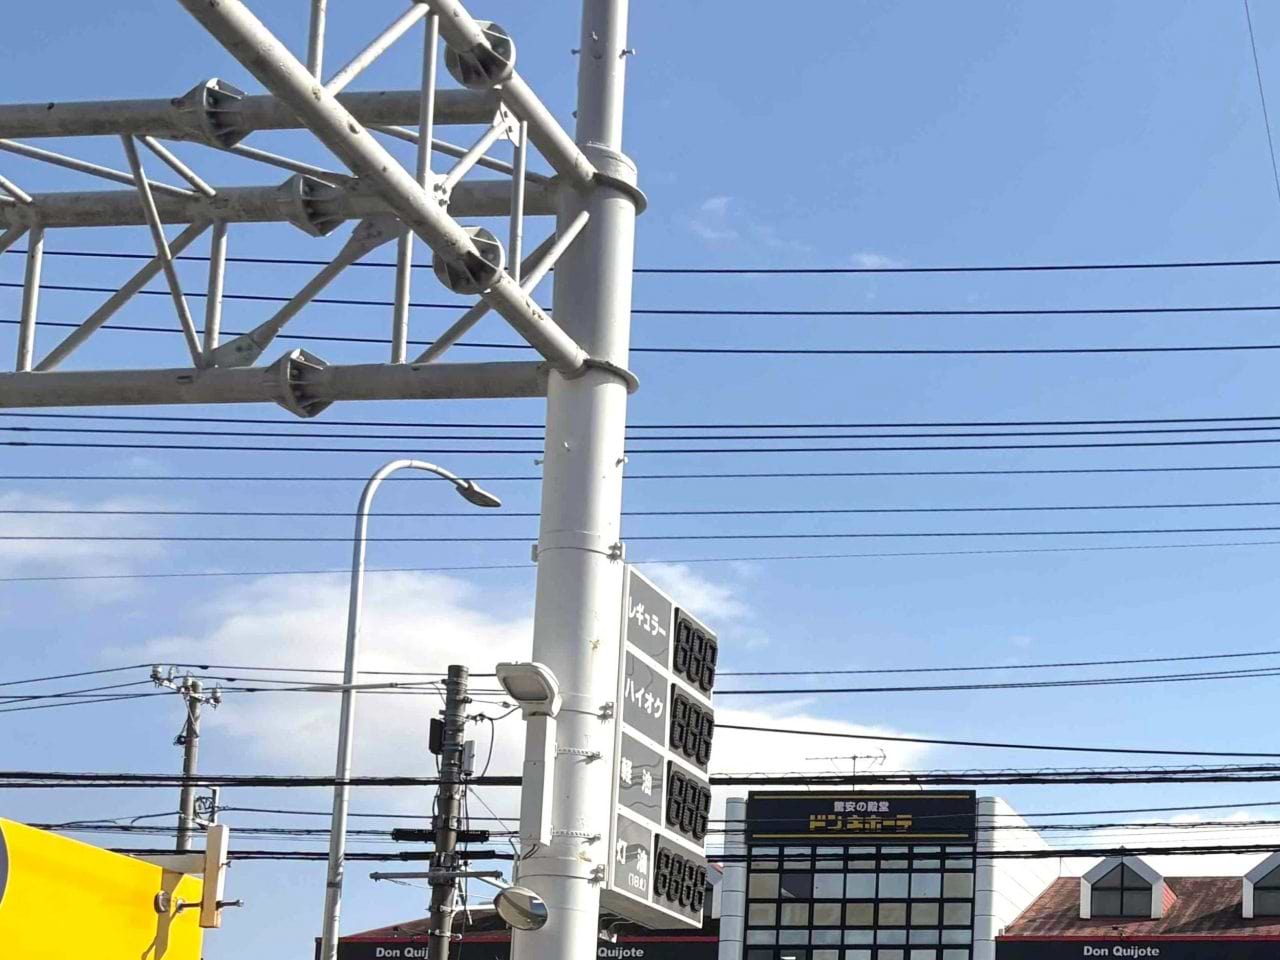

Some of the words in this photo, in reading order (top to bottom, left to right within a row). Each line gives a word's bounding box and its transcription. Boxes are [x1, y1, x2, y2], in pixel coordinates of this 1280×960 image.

[627, 596, 667, 637] レギュラー
[625, 678, 664, 719] ハイオク
[376, 948, 400, 958] Don
[597, 947, 645, 960] Quijote
[1083, 945, 1109, 957] Don
[1113, 945, 1160, 959] Quijote
